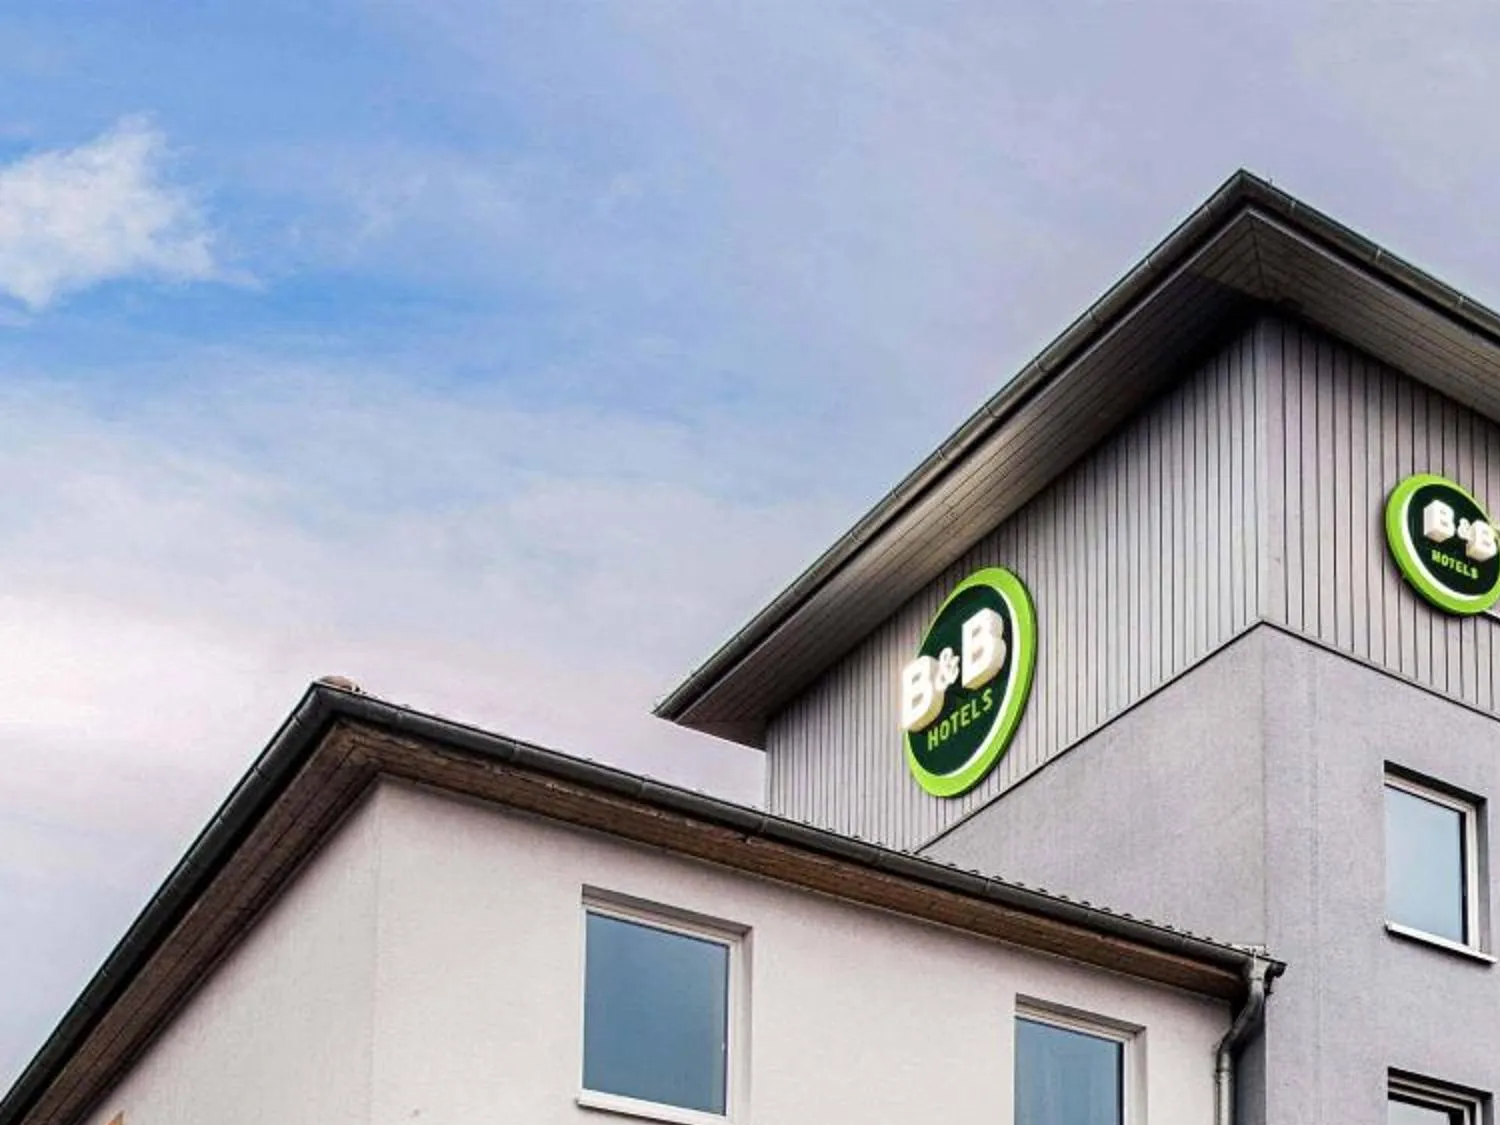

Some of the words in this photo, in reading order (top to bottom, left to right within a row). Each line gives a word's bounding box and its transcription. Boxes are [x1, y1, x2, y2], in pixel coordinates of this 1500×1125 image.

[1423, 500, 1497, 562] B&B
[1431, 550, 1479, 579] HOTELS
[901, 608, 1006, 732] B&B
[928, 688, 993, 750] HOTELS
